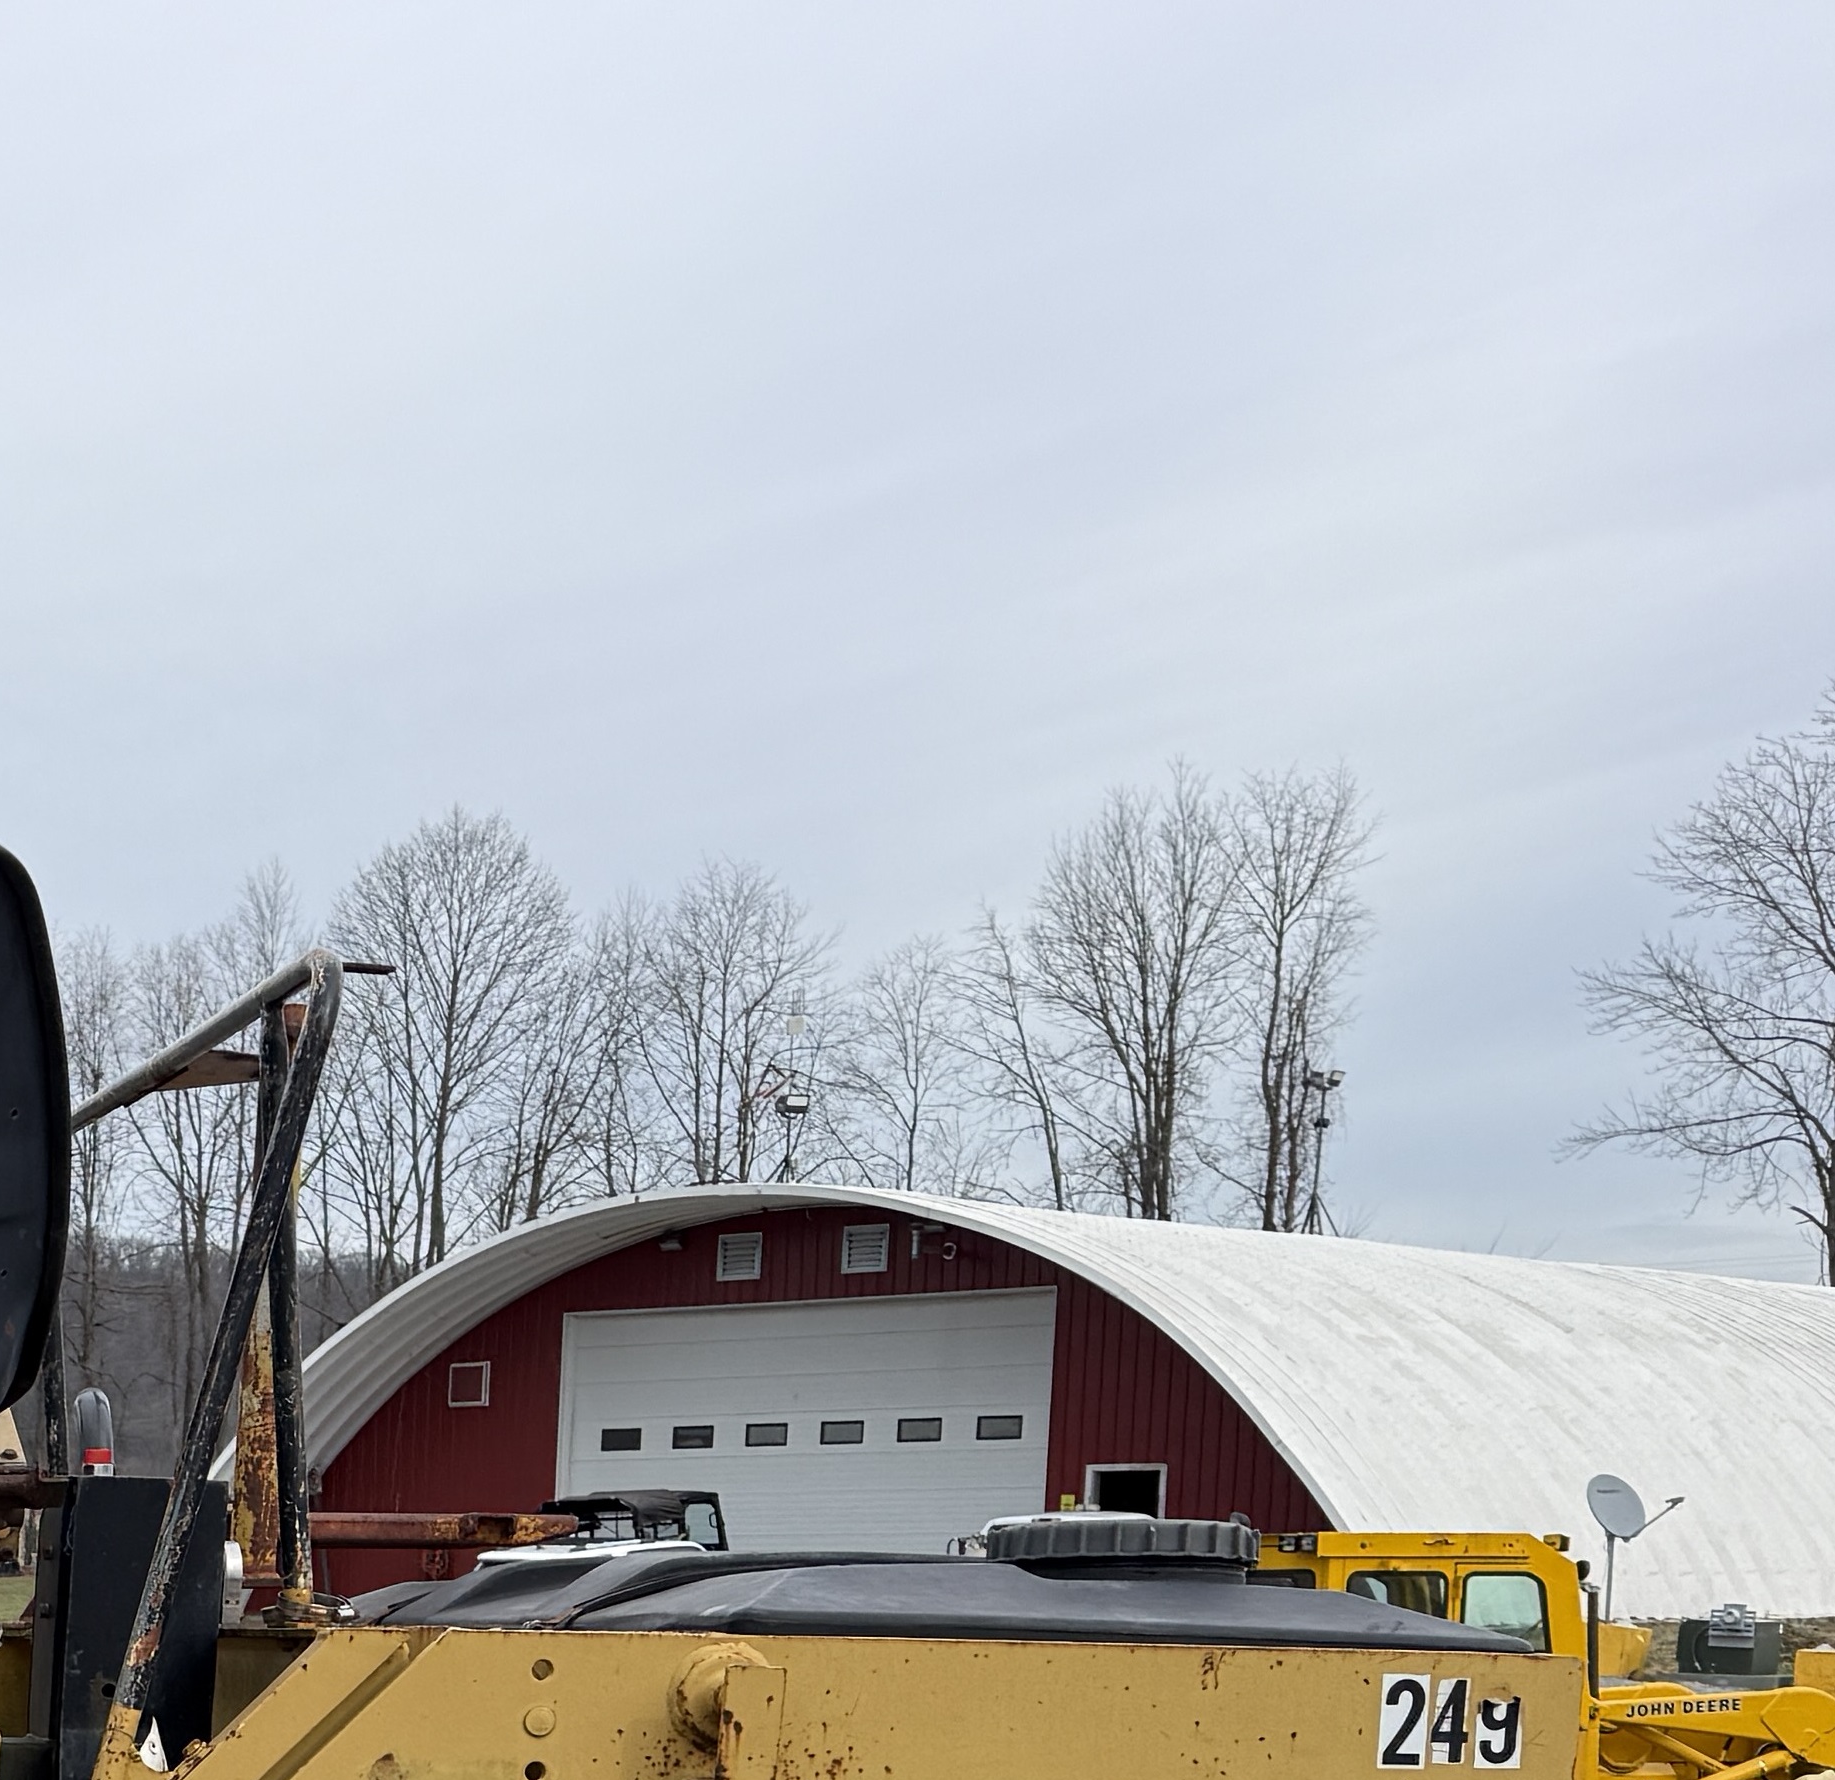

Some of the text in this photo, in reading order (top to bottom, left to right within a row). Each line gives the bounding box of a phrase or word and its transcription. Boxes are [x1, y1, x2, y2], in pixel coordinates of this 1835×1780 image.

[1382, 1678, 1522, 1765] 249
[1626, 1698, 1742, 1718] JOHN DEERE
